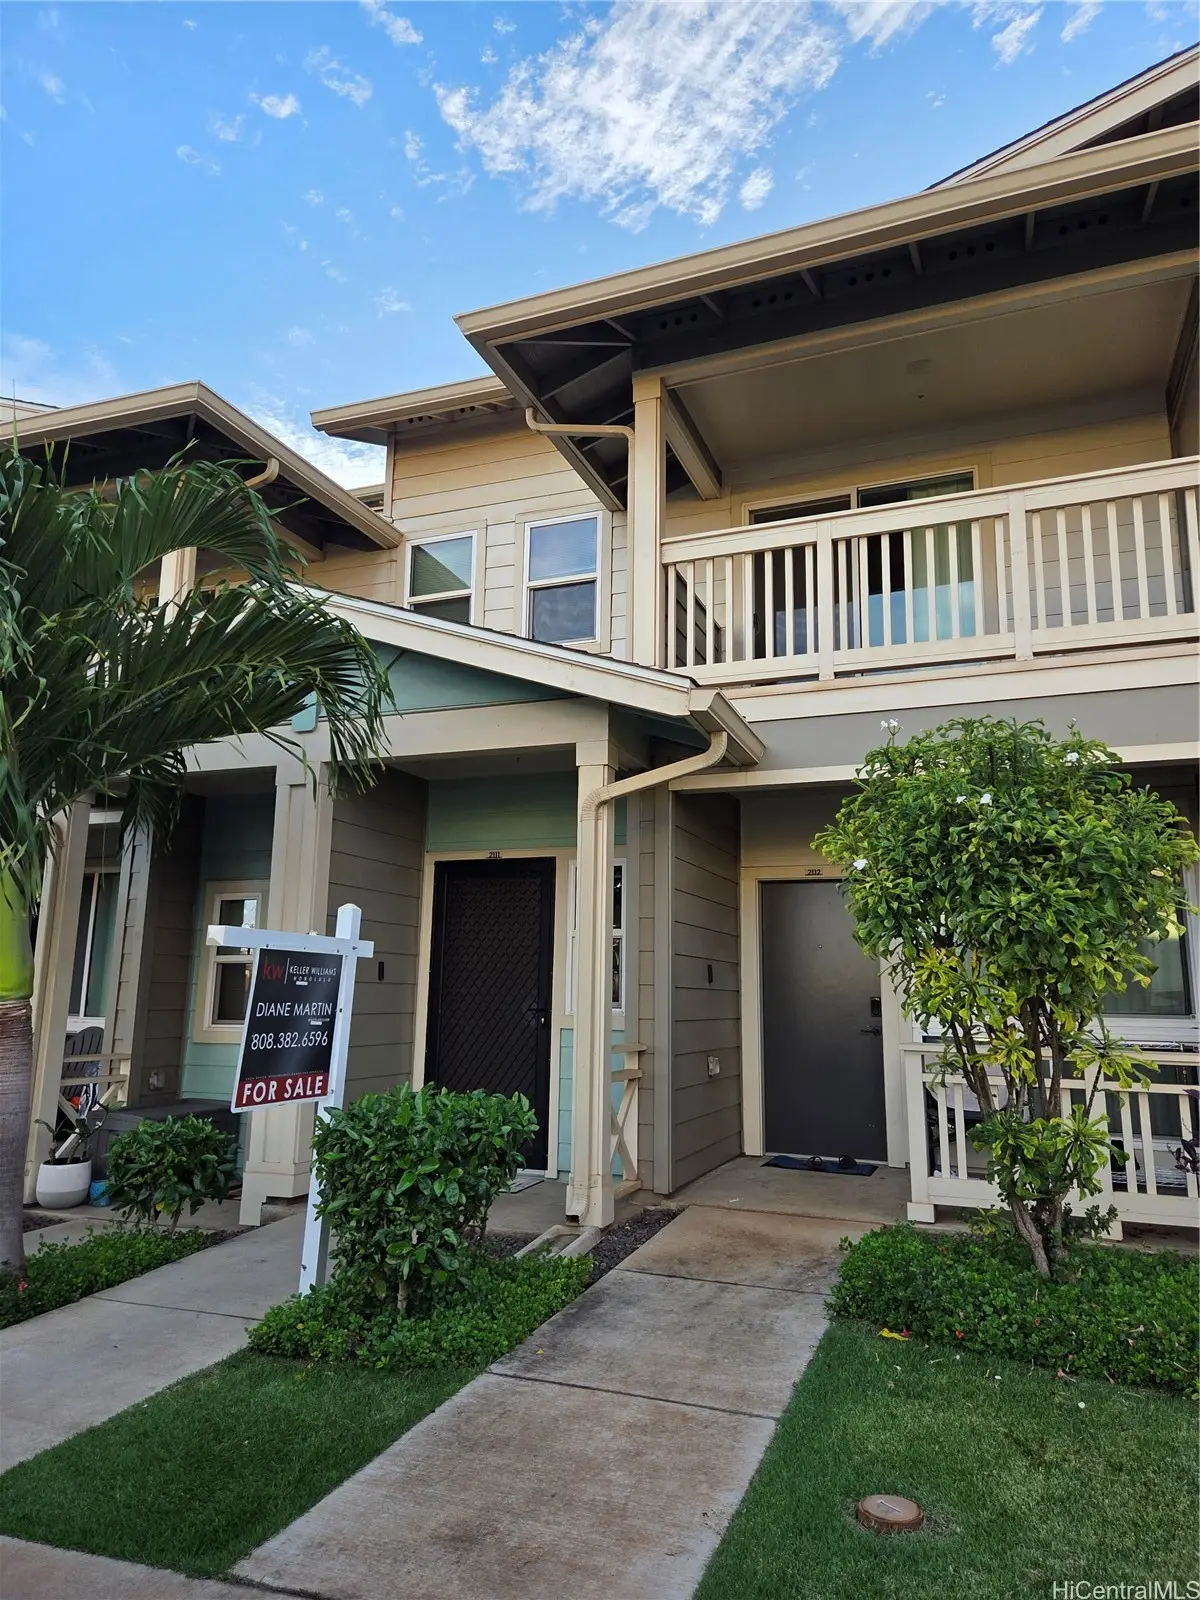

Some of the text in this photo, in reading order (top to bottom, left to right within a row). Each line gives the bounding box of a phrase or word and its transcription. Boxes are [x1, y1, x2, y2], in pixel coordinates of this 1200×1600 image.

[263, 956, 284, 980] kw
[290, 965, 336, 976] KELLER WILLIAMS
[256, 1002, 332, 1017] DIANE MARTIN
[251, 1031, 328, 1050] 808.382.6596
[242, 1076, 324, 1104] FOR SALE
